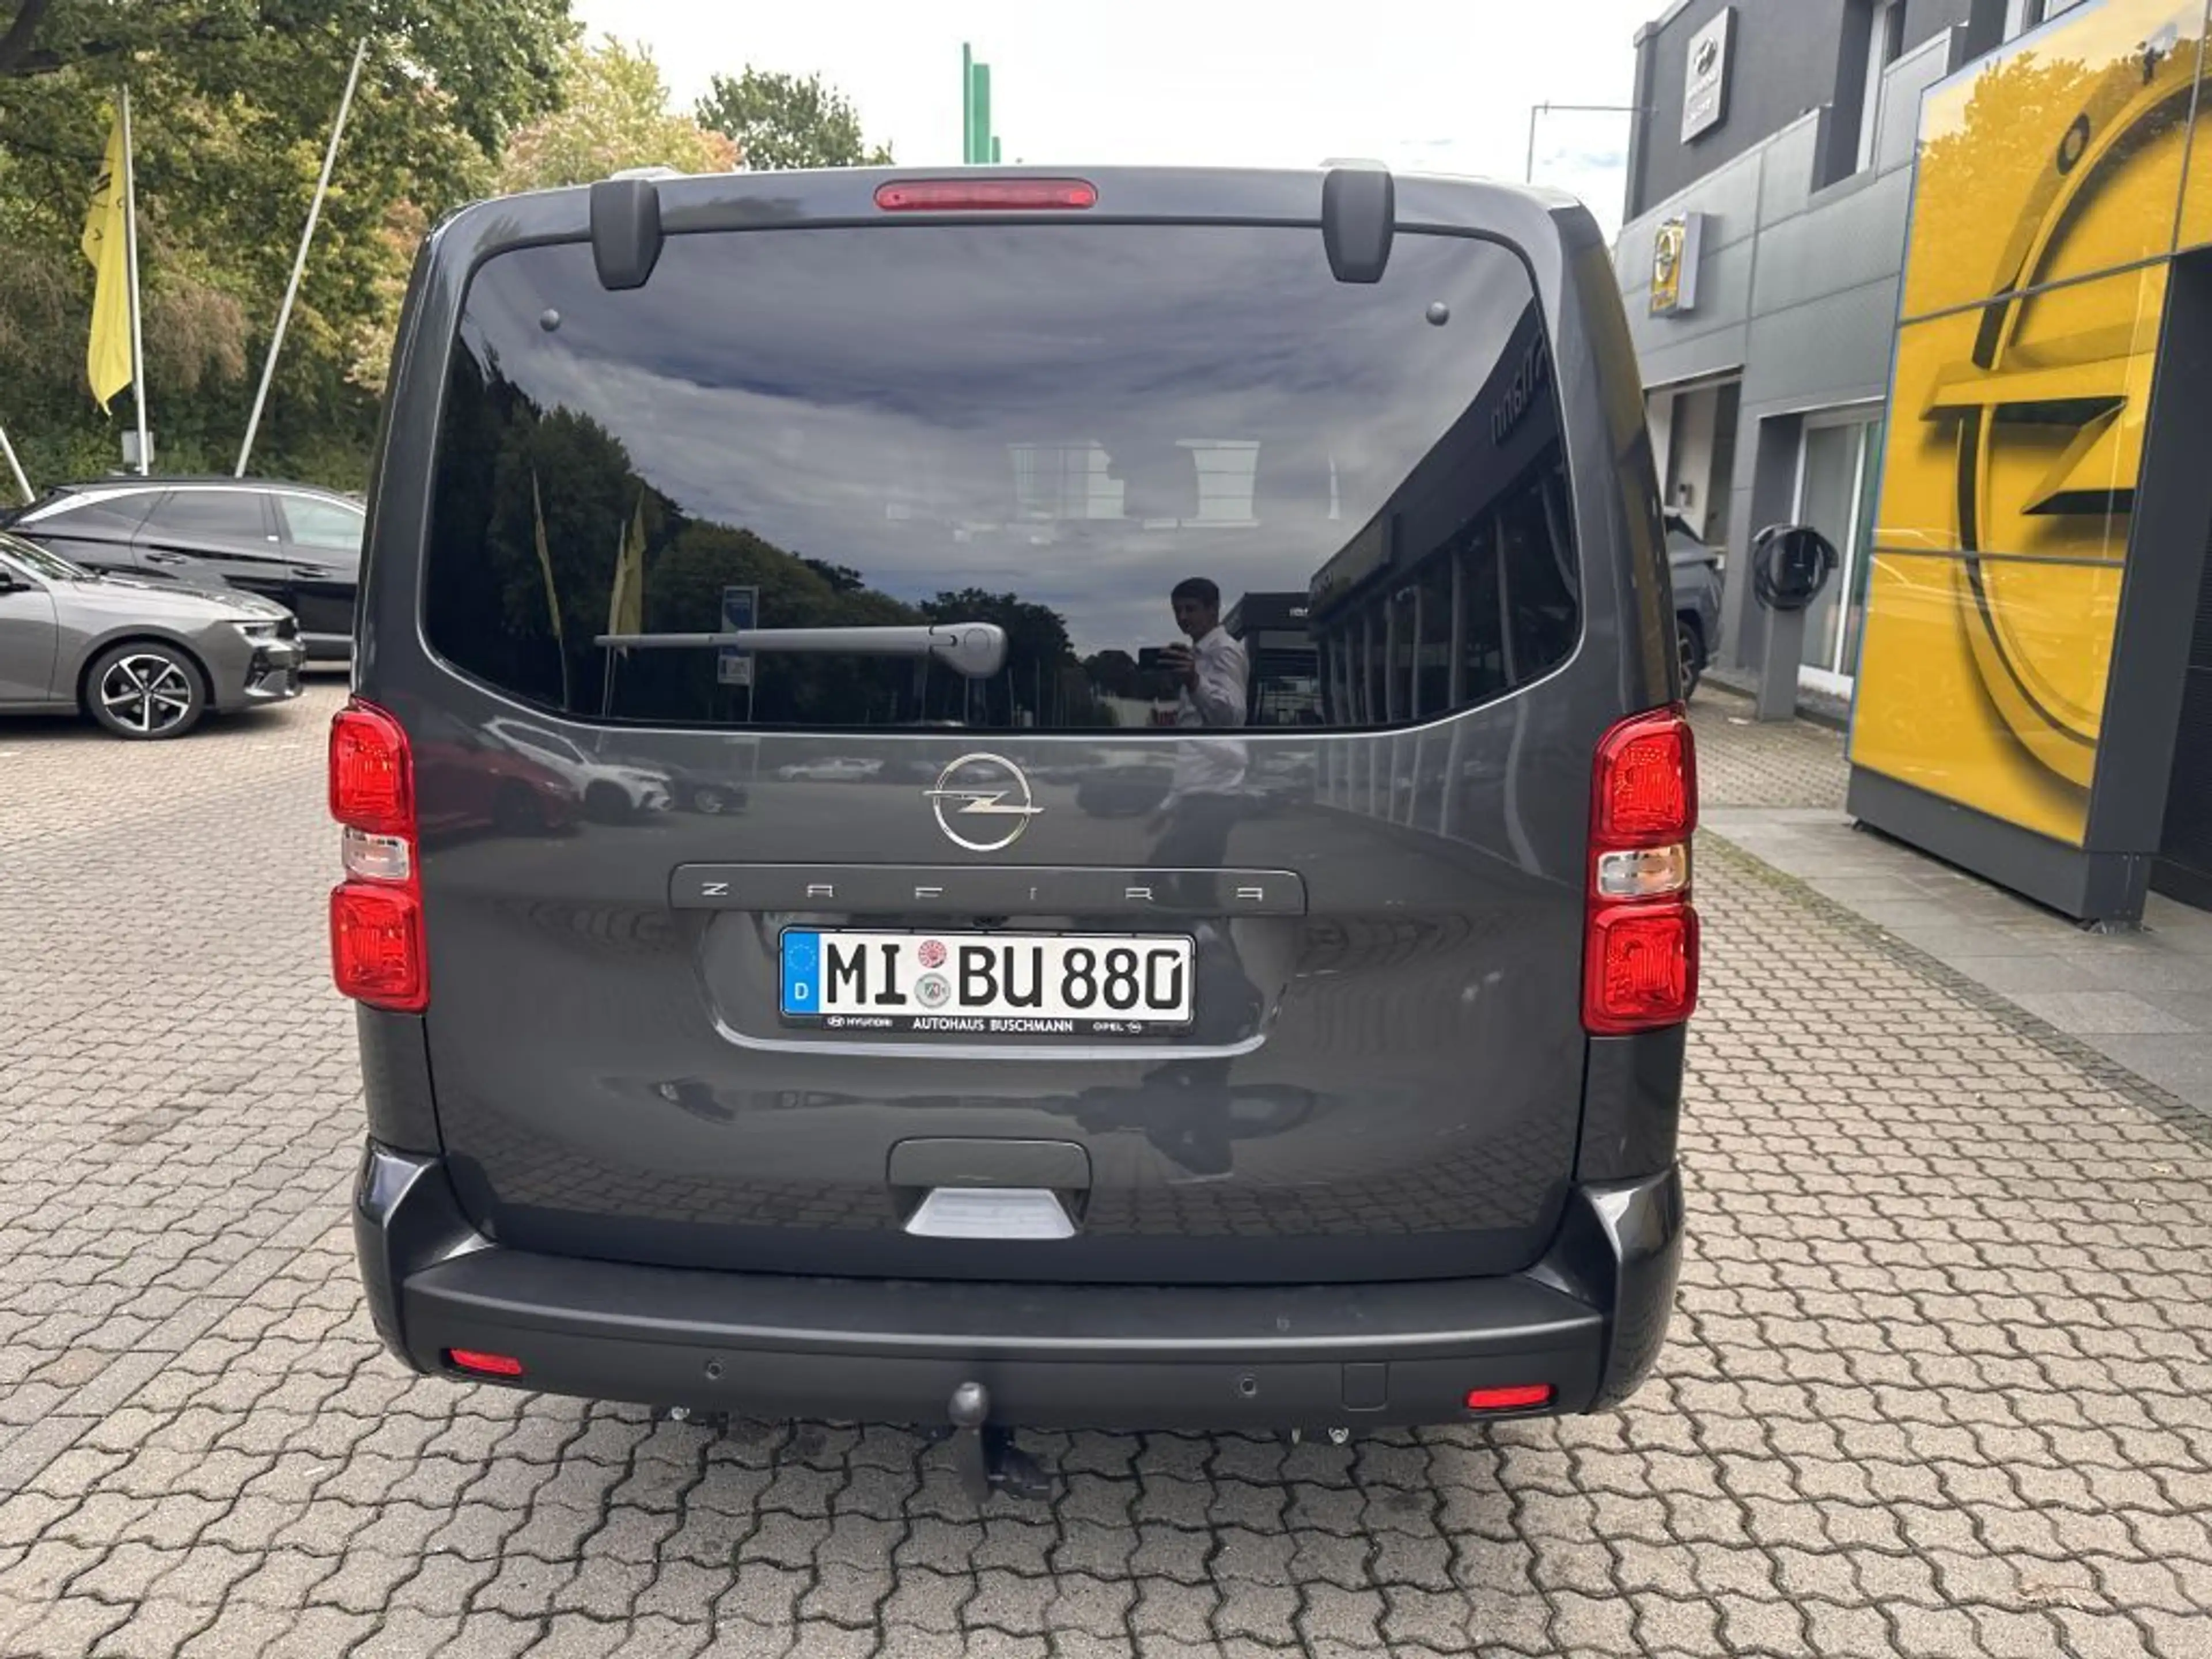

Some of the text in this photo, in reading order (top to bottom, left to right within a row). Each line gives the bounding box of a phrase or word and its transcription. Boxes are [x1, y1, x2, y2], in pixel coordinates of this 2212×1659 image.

[702, 882, 1264, 901] ZAFIRA
[827, 944, 1182, 1010] MI BU 880
[794, 982, 809, 999] D
[913, 1017, 1073, 1032] AUTOHAUS BUSCHMANN
[1093, 1021, 1124, 1032] OPEL
